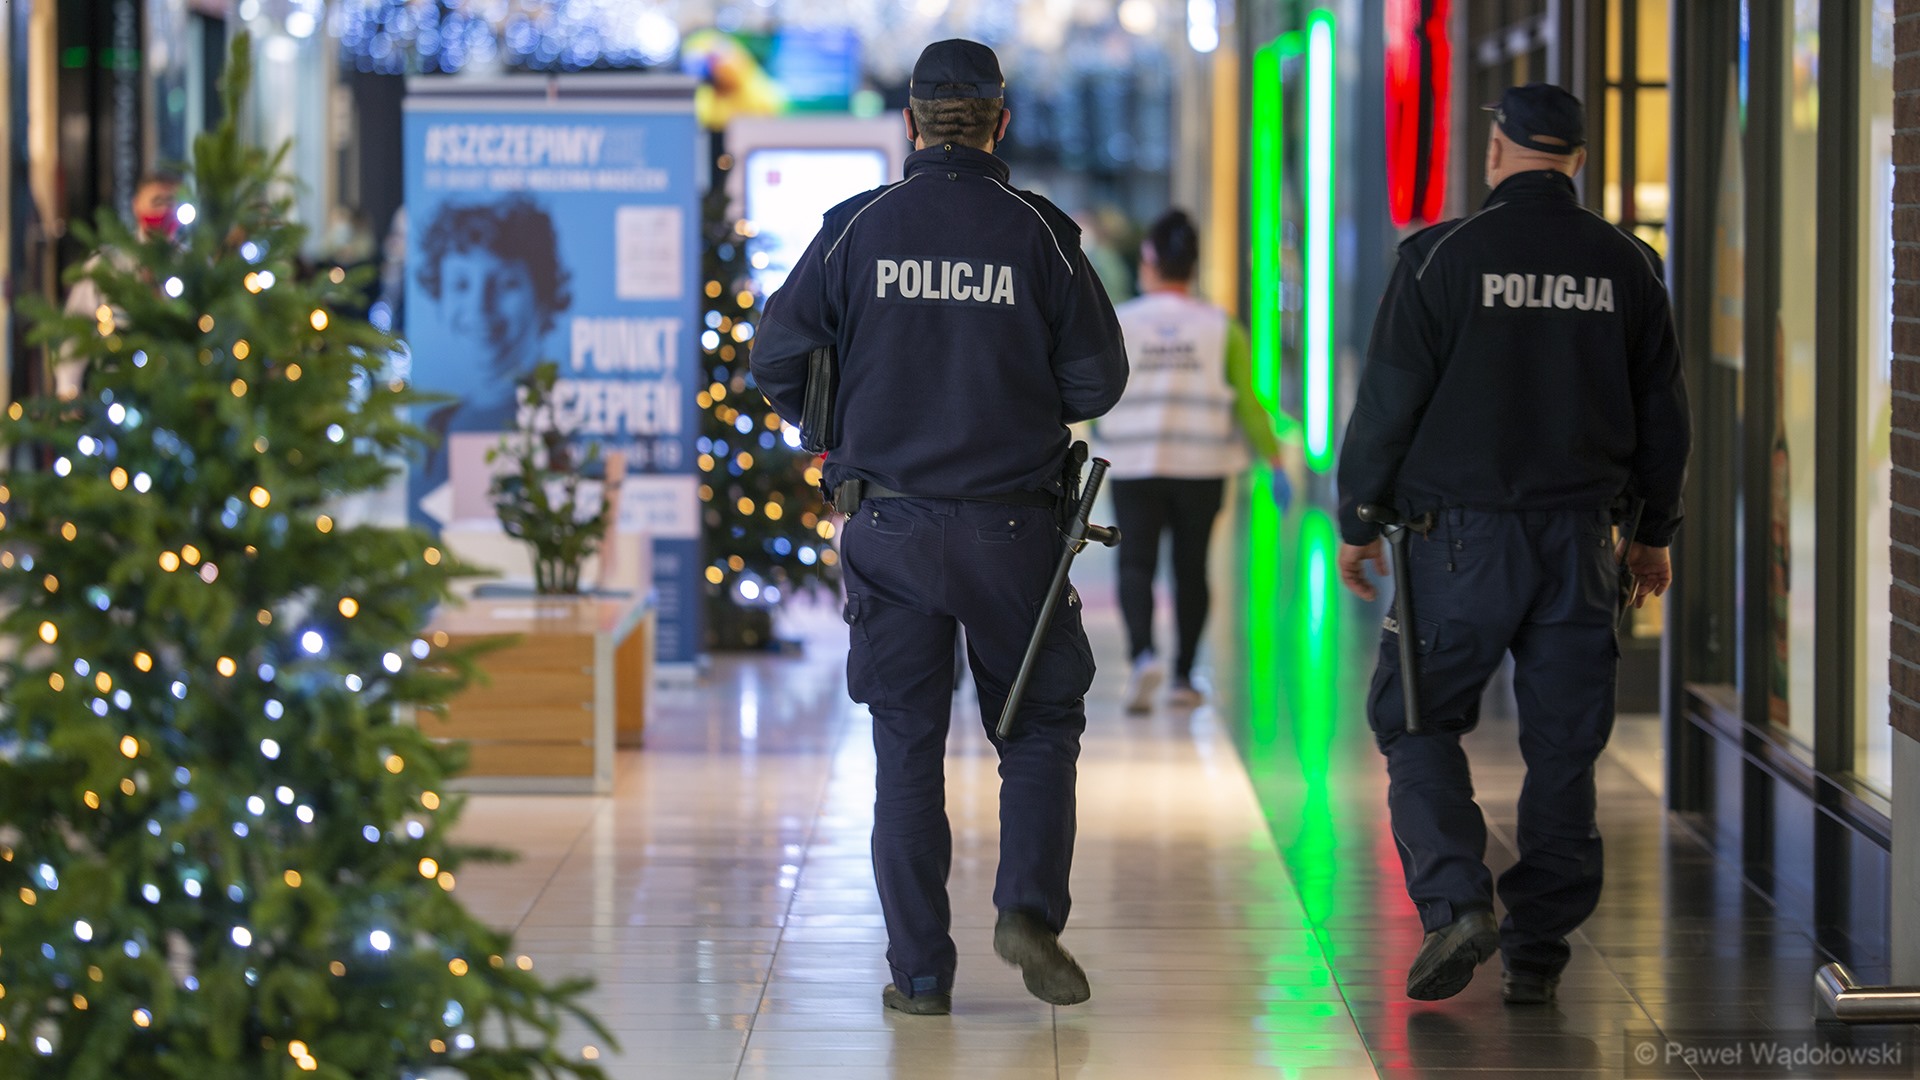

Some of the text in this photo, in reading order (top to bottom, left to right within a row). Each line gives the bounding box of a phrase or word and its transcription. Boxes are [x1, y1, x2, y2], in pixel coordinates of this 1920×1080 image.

[425, 125, 647, 168] #SZCZEPIMY
[876, 259, 1015, 305] POLICJA
[1482, 273, 1615, 312] POLICJA
[570, 316, 682, 372] PUNKT
